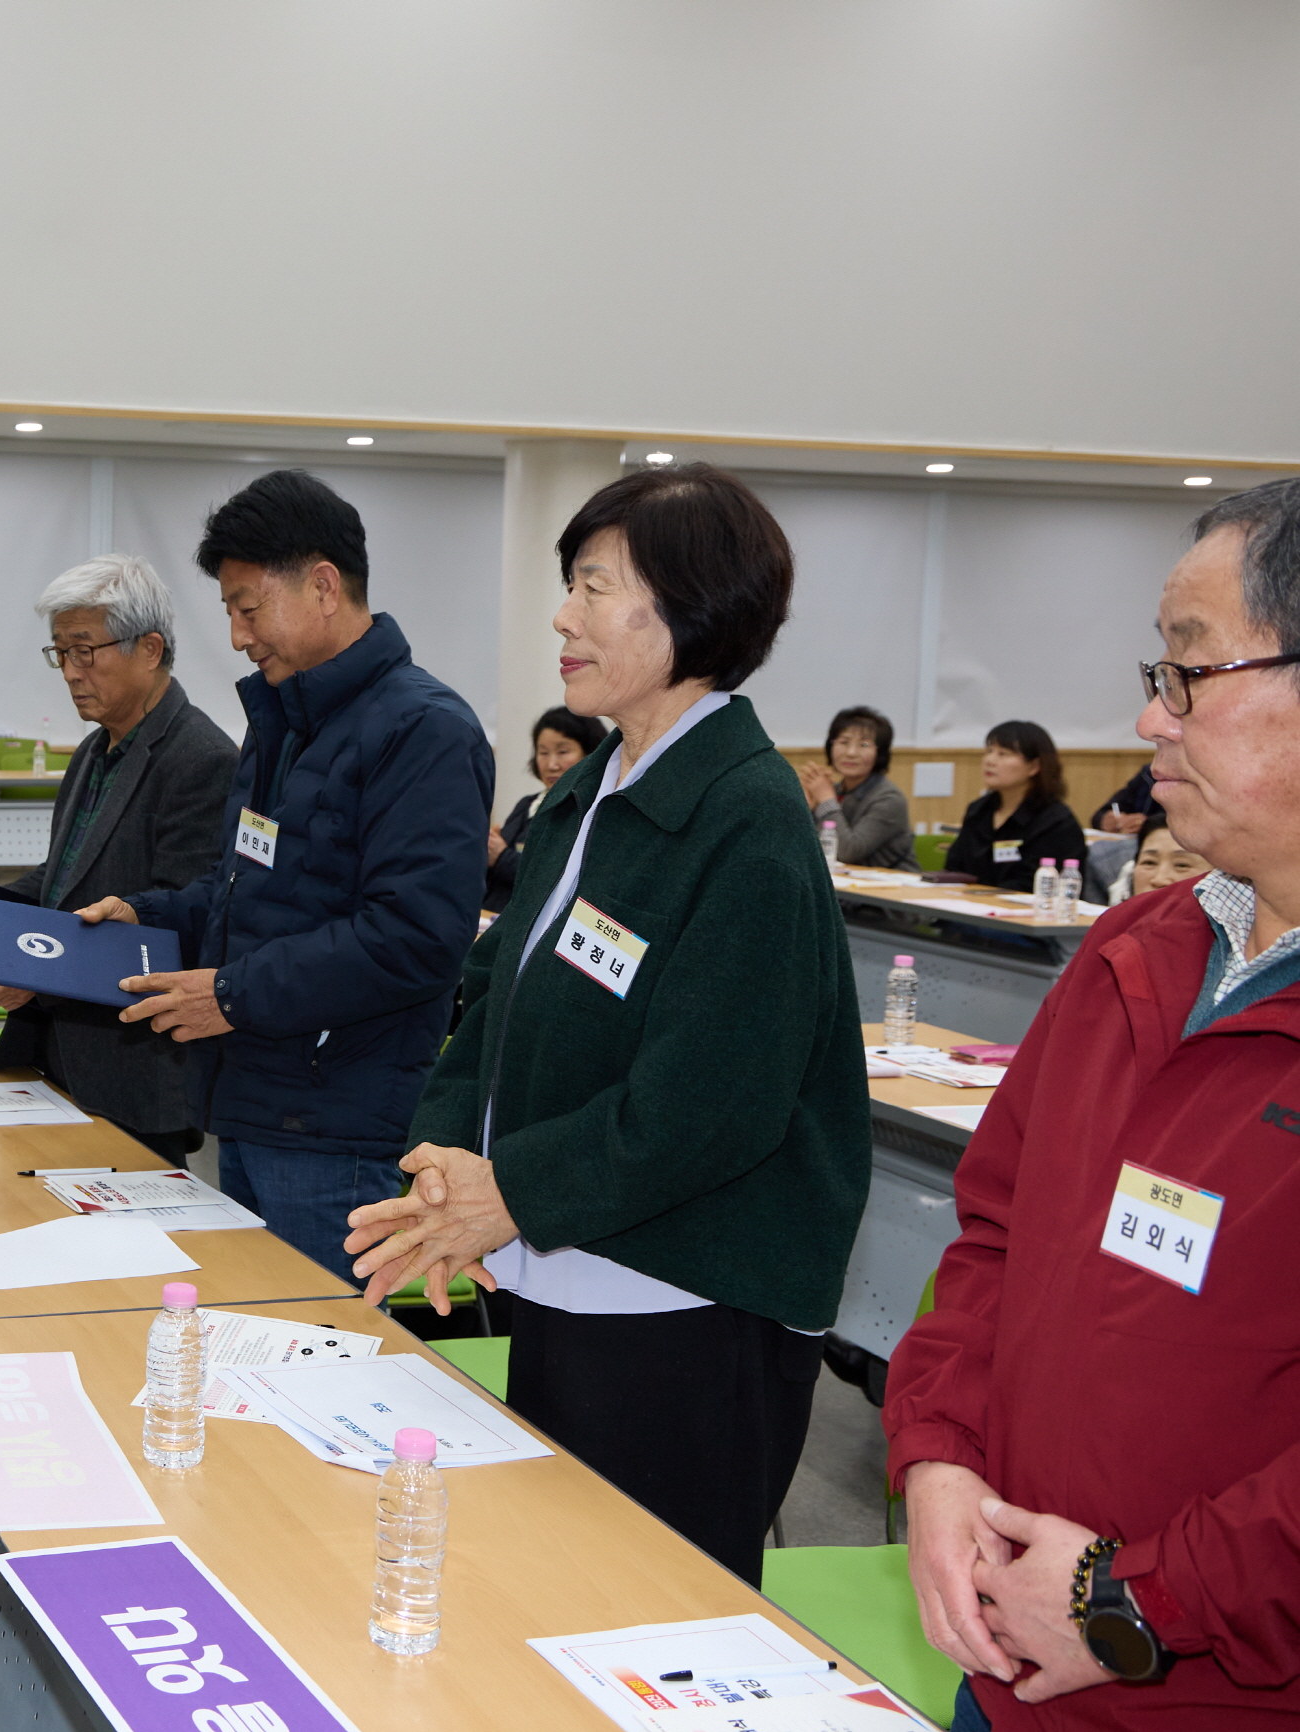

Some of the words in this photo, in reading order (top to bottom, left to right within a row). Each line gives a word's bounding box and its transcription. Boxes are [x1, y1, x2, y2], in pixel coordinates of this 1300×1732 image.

[251, 817, 265, 830] 도산면
[594, 918, 621, 942] 도산면
[1150, 1183, 1184, 1209] 광도면
[100, 1606, 249, 1694] 잇다
[701, 1679, 745, 1703] 발대
[736, 1679, 773, 1699] 특강
